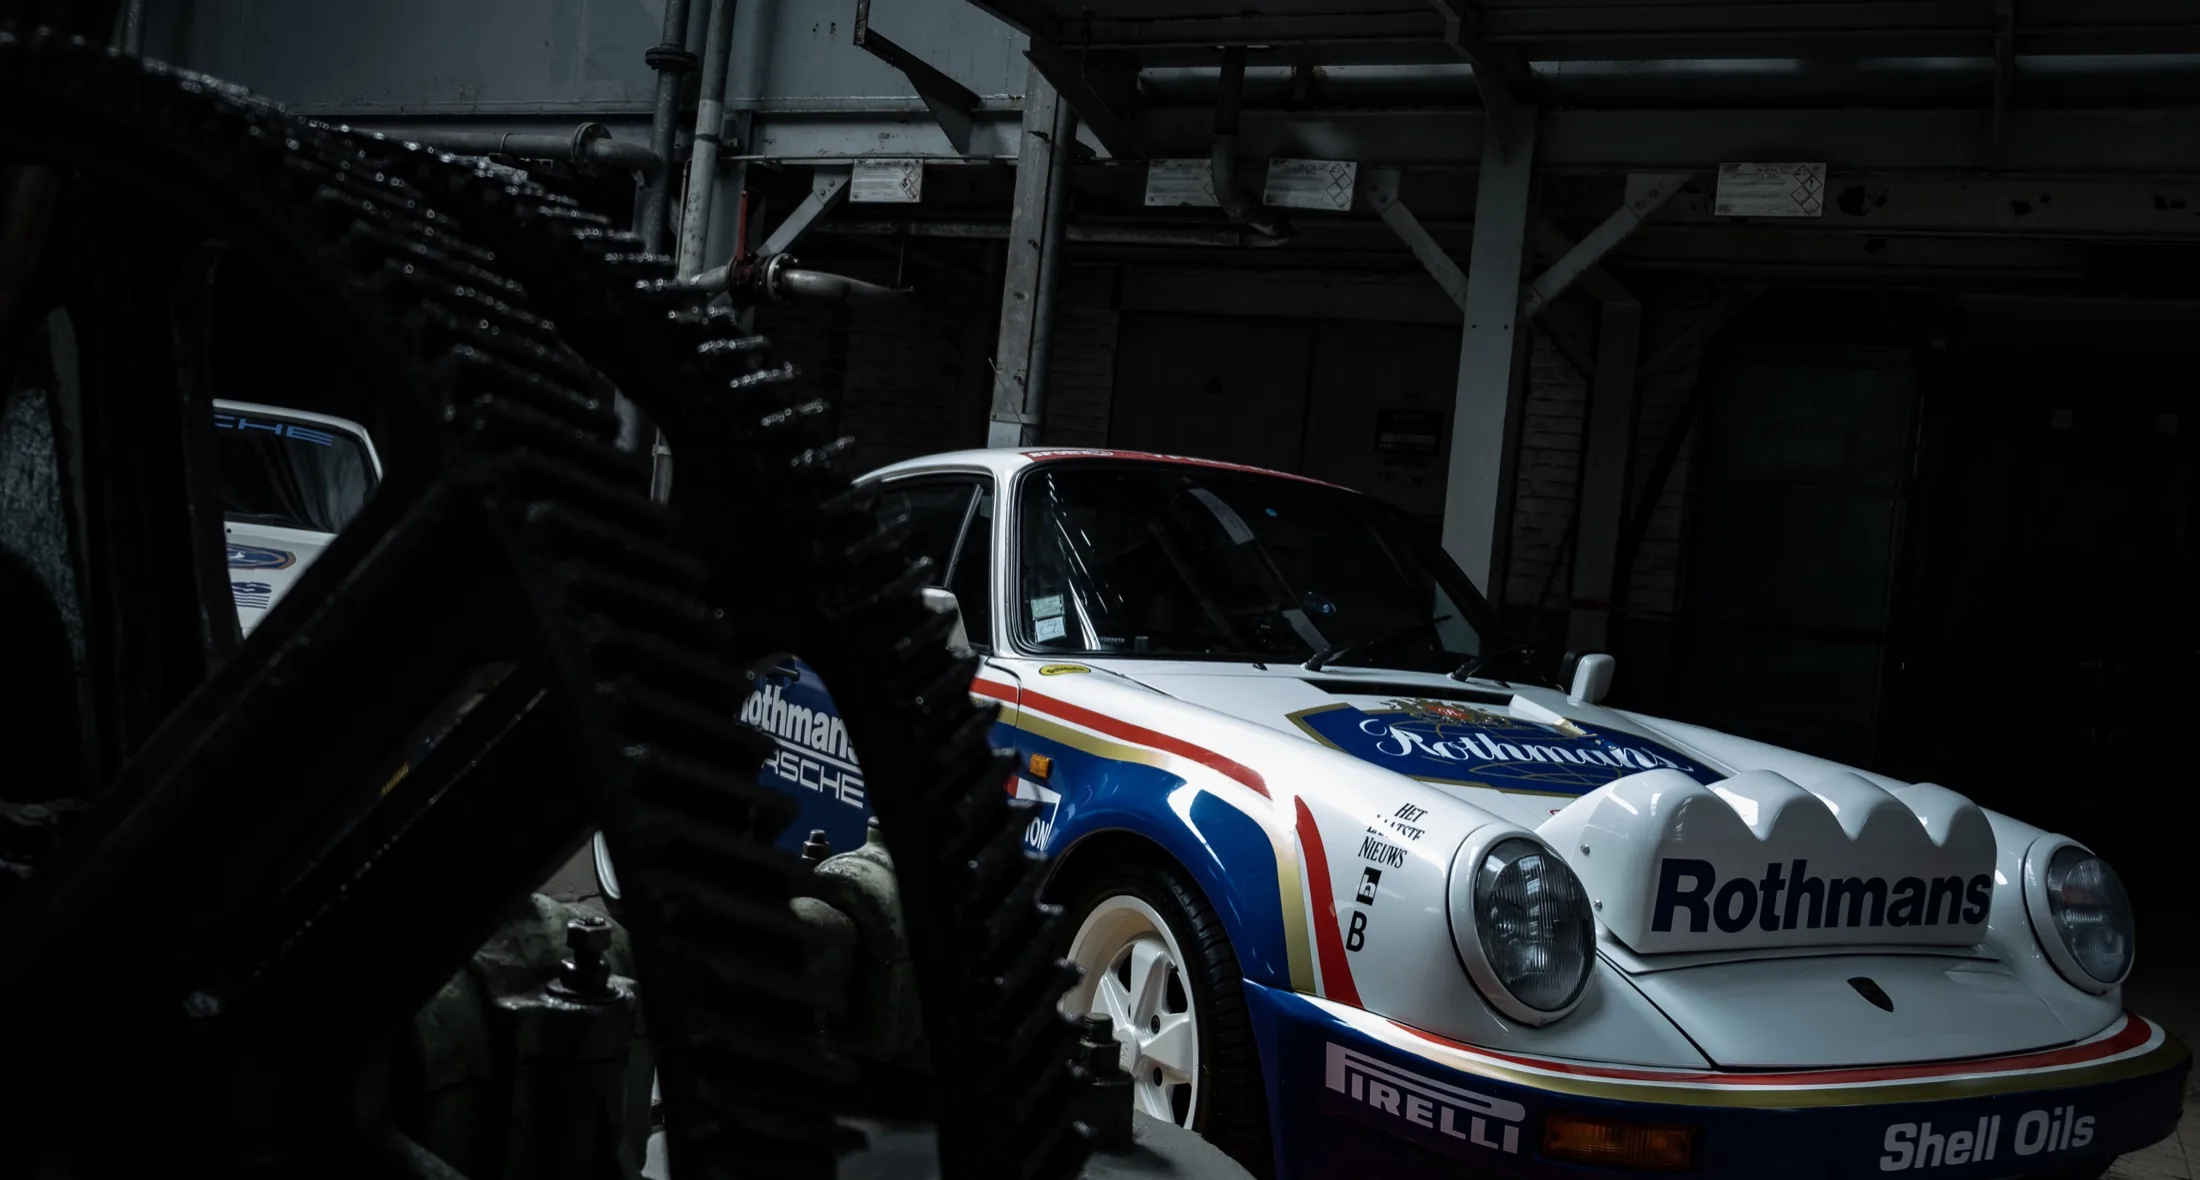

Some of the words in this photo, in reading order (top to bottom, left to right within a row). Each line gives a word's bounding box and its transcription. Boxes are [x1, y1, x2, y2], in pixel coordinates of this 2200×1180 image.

[1359, 718, 1694, 773] Rothmans
[1394, 802, 1428, 823] HET
[1358, 836, 1408, 869] NIEUWS
[1650, 857, 1993, 933] Rothmans
[1345, 909, 1367, 952] B
[1325, 1041, 1526, 1155] PIRELLI
[1879, 1114, 2001, 1172] Shell
[2013, 1104, 2096, 1156] Oils
